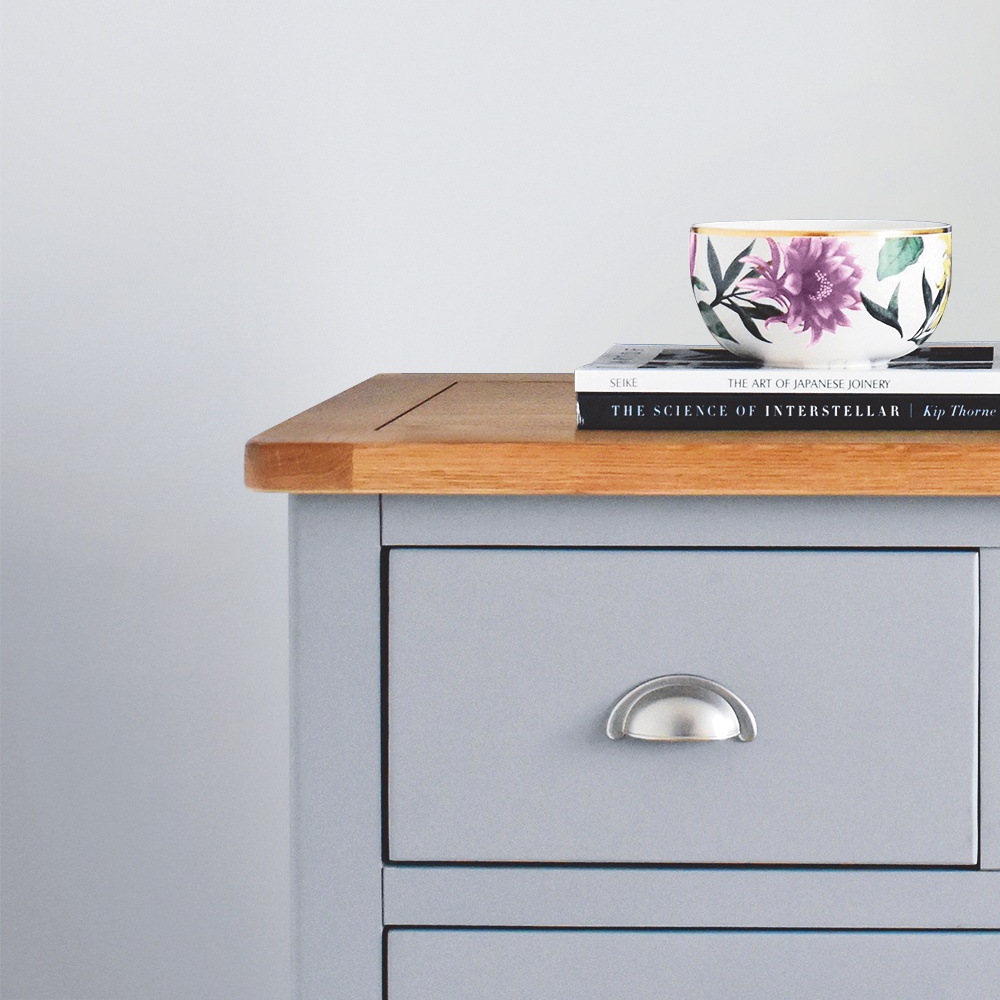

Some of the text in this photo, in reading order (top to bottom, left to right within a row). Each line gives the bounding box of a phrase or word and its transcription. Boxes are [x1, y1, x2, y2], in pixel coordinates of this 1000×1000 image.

[609, 378, 638, 388] SEIKE
[728, 379, 891, 390] THE ART OF JAPANESE JOINERY
[611, 404, 997, 421] THE SCIENCE OF INTERSTELLAR Kip Thorne
